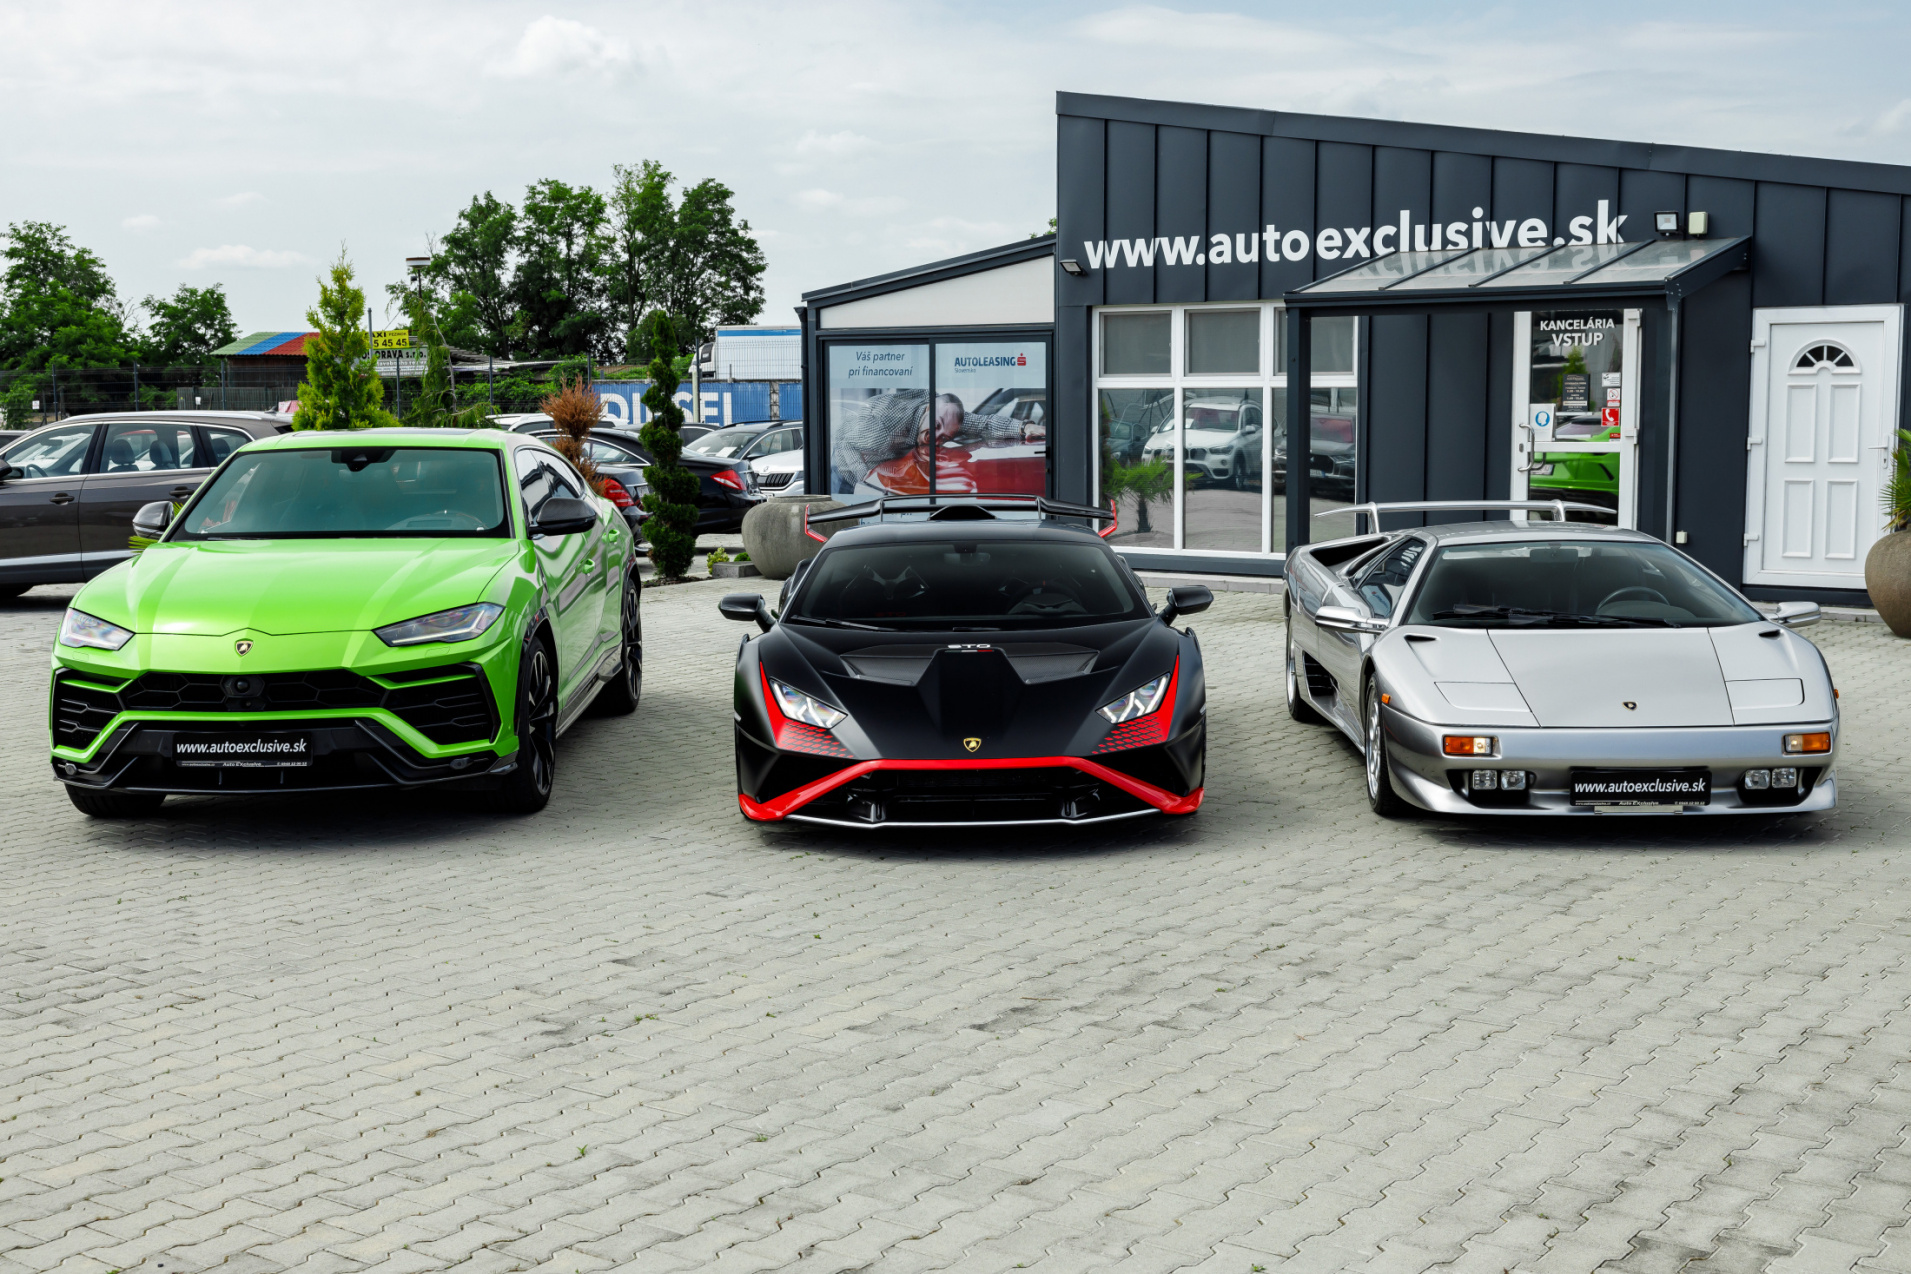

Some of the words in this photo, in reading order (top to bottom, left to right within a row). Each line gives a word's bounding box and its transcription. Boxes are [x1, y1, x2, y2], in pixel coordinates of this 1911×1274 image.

[1084, 199, 1629, 269] www.autoexclusive.sk
[1540, 317, 1616, 331] KANCELÁRIA
[382, 339, 393, 347] 45
[396, 339, 407, 347] 45
[1551, 333, 1604, 347] VSTUP
[856, 351, 872, 361] Váš
[872, 352, 905, 364] partner
[954, 357, 1016, 367] AUTOLEASING
[848, 366, 861, 379] pri
[862, 365, 914, 376] financovaní
[176, 738, 307, 753] www.autoexclusive.sk
[1574, 777, 1706, 793] www.autoexclusive.sk
